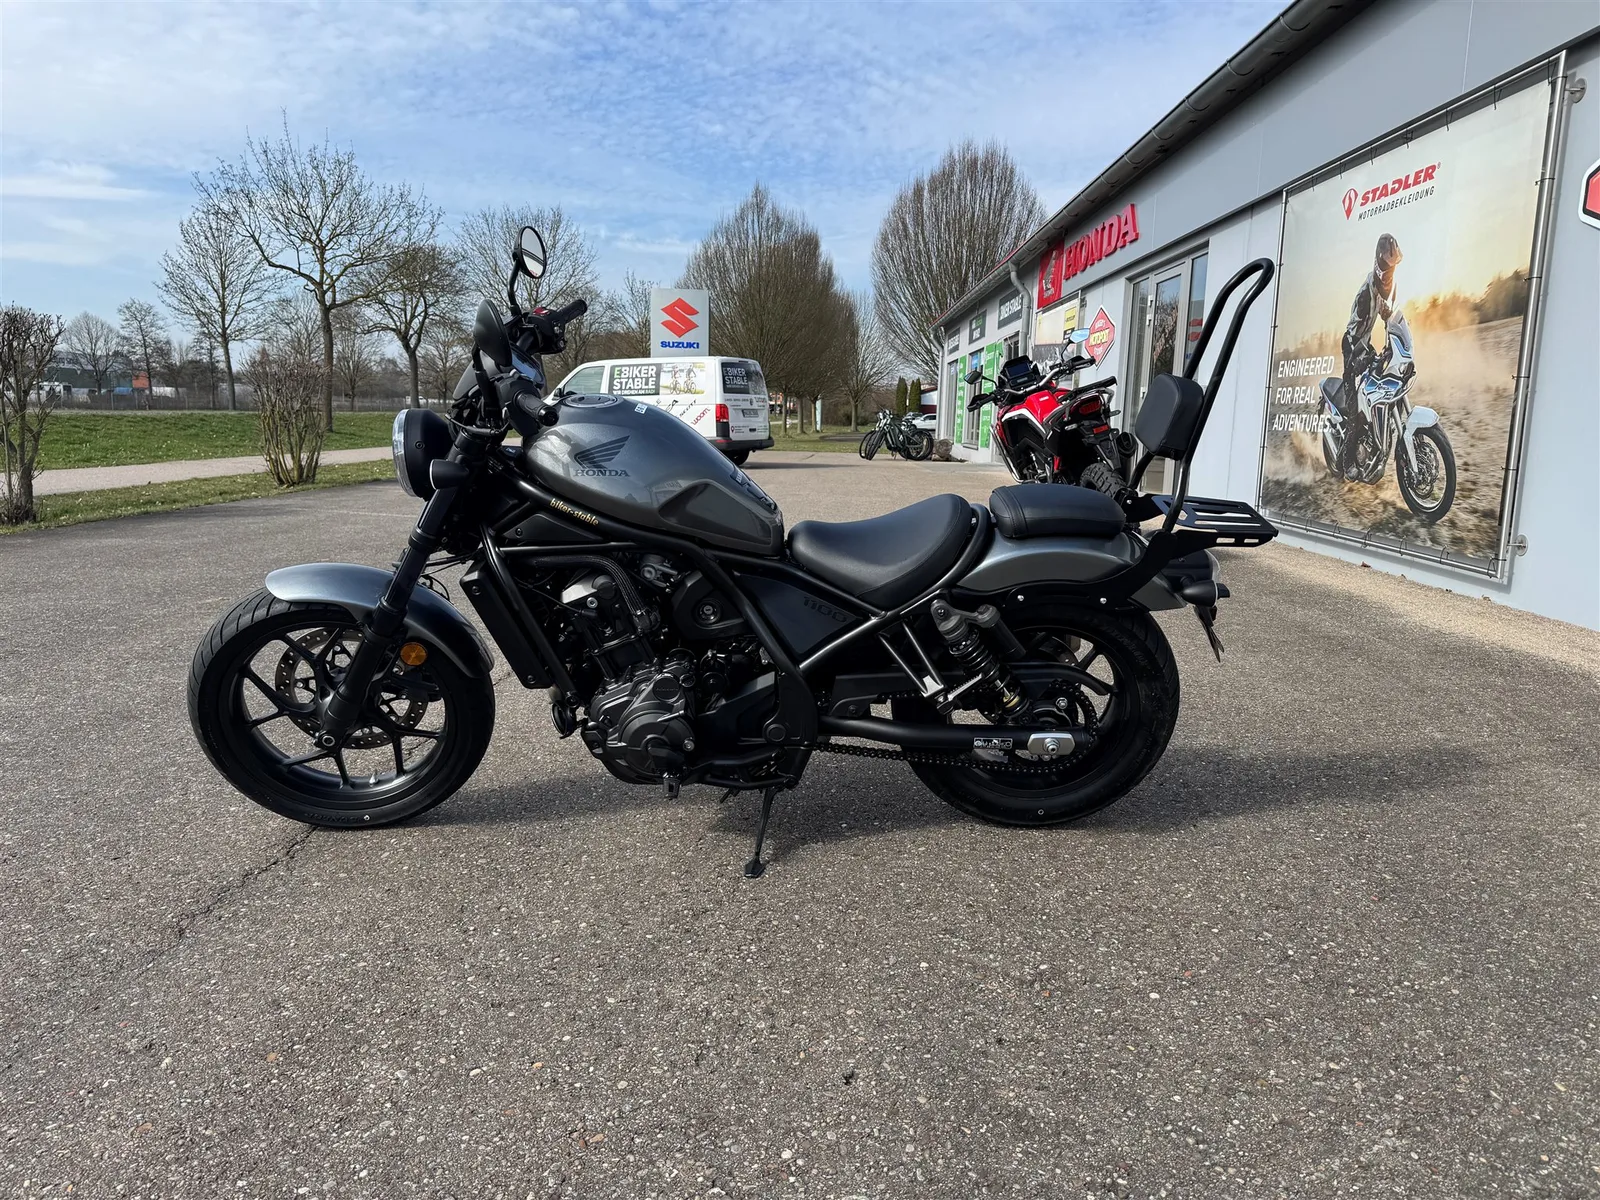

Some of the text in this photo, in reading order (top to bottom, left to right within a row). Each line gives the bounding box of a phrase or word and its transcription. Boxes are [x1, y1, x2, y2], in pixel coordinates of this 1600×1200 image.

[1360, 164, 1437, 207] STADLER
[1358, 186, 1435, 221] MOTORRADBEKLEIDUNG
[1063, 203, 1140, 281] HONDA
[660, 340, 700, 350] SUZUKI
[1277, 355, 1335, 378] ENGINEERED
[613, 378, 656, 389] STABLE
[725, 376, 748, 385] STABLE
[1275, 386, 1316, 404] FOR REAL
[691, 407, 711, 426] woom
[1272, 413, 1333, 433] ADVENTURES.
[574, 469, 631, 477] HONDA
[549, 498, 599, 526] biker-stable
